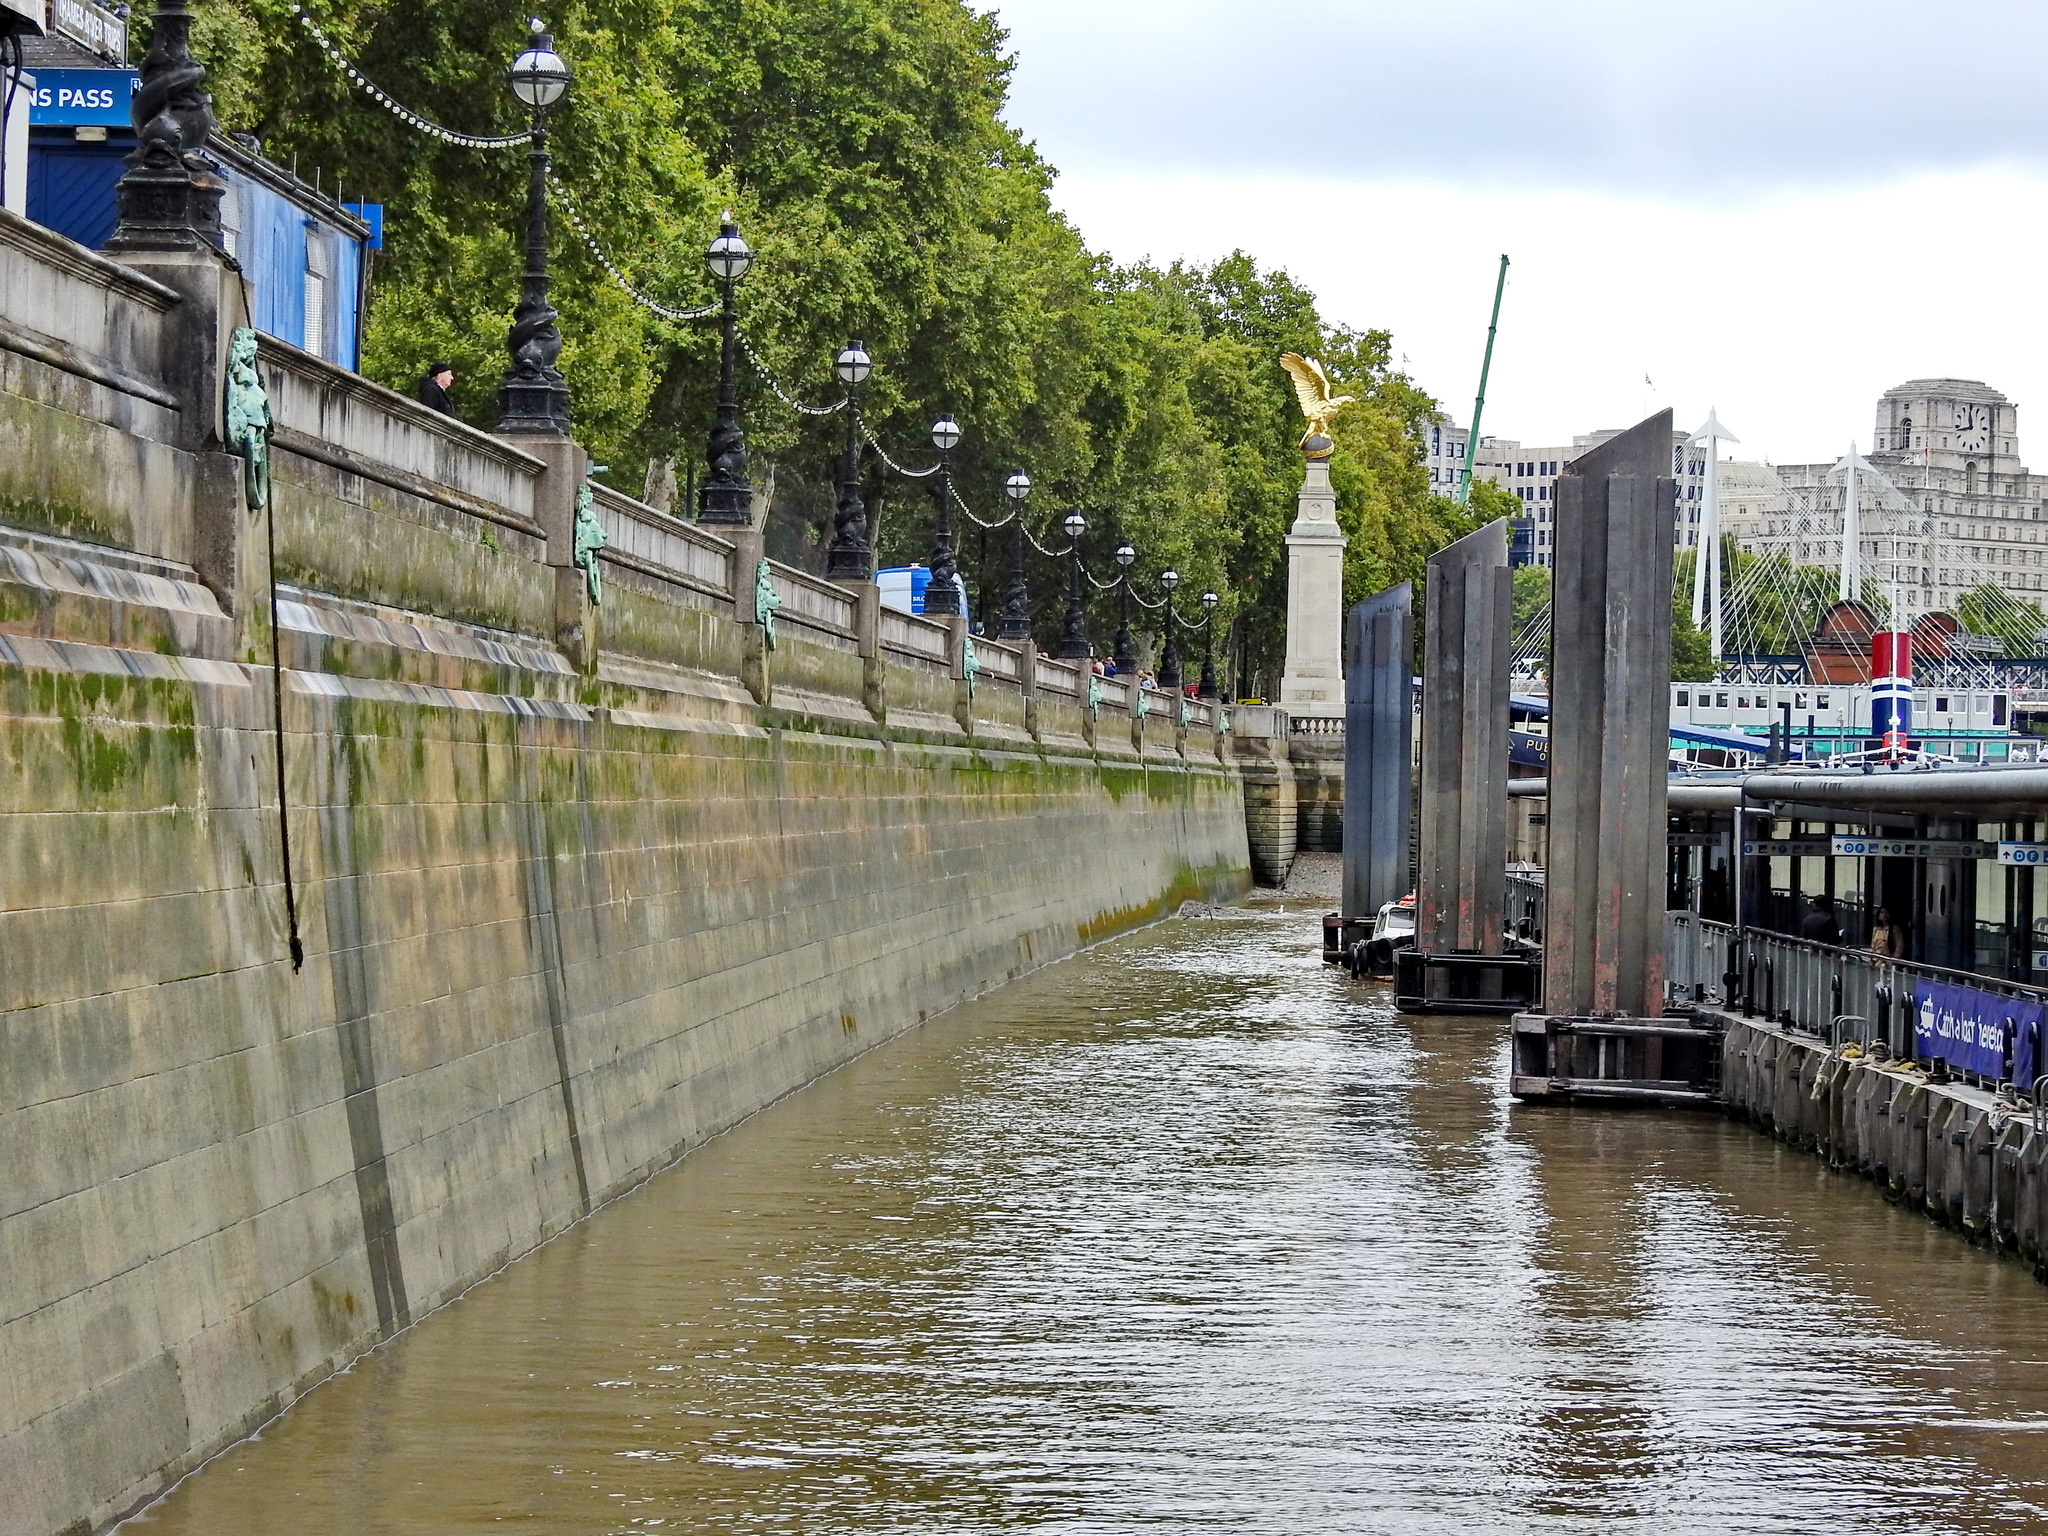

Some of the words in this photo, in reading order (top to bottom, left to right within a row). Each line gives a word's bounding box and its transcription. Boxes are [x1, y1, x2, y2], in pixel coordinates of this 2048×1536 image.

[84, 9, 103, 43] RIVER
[103, 21, 121, 53] TRIPS
[58, 88, 114, 108] PASS
[1936, 1007, 1954, 1039] Catch
[1954, 1018, 1961, 1040] a
